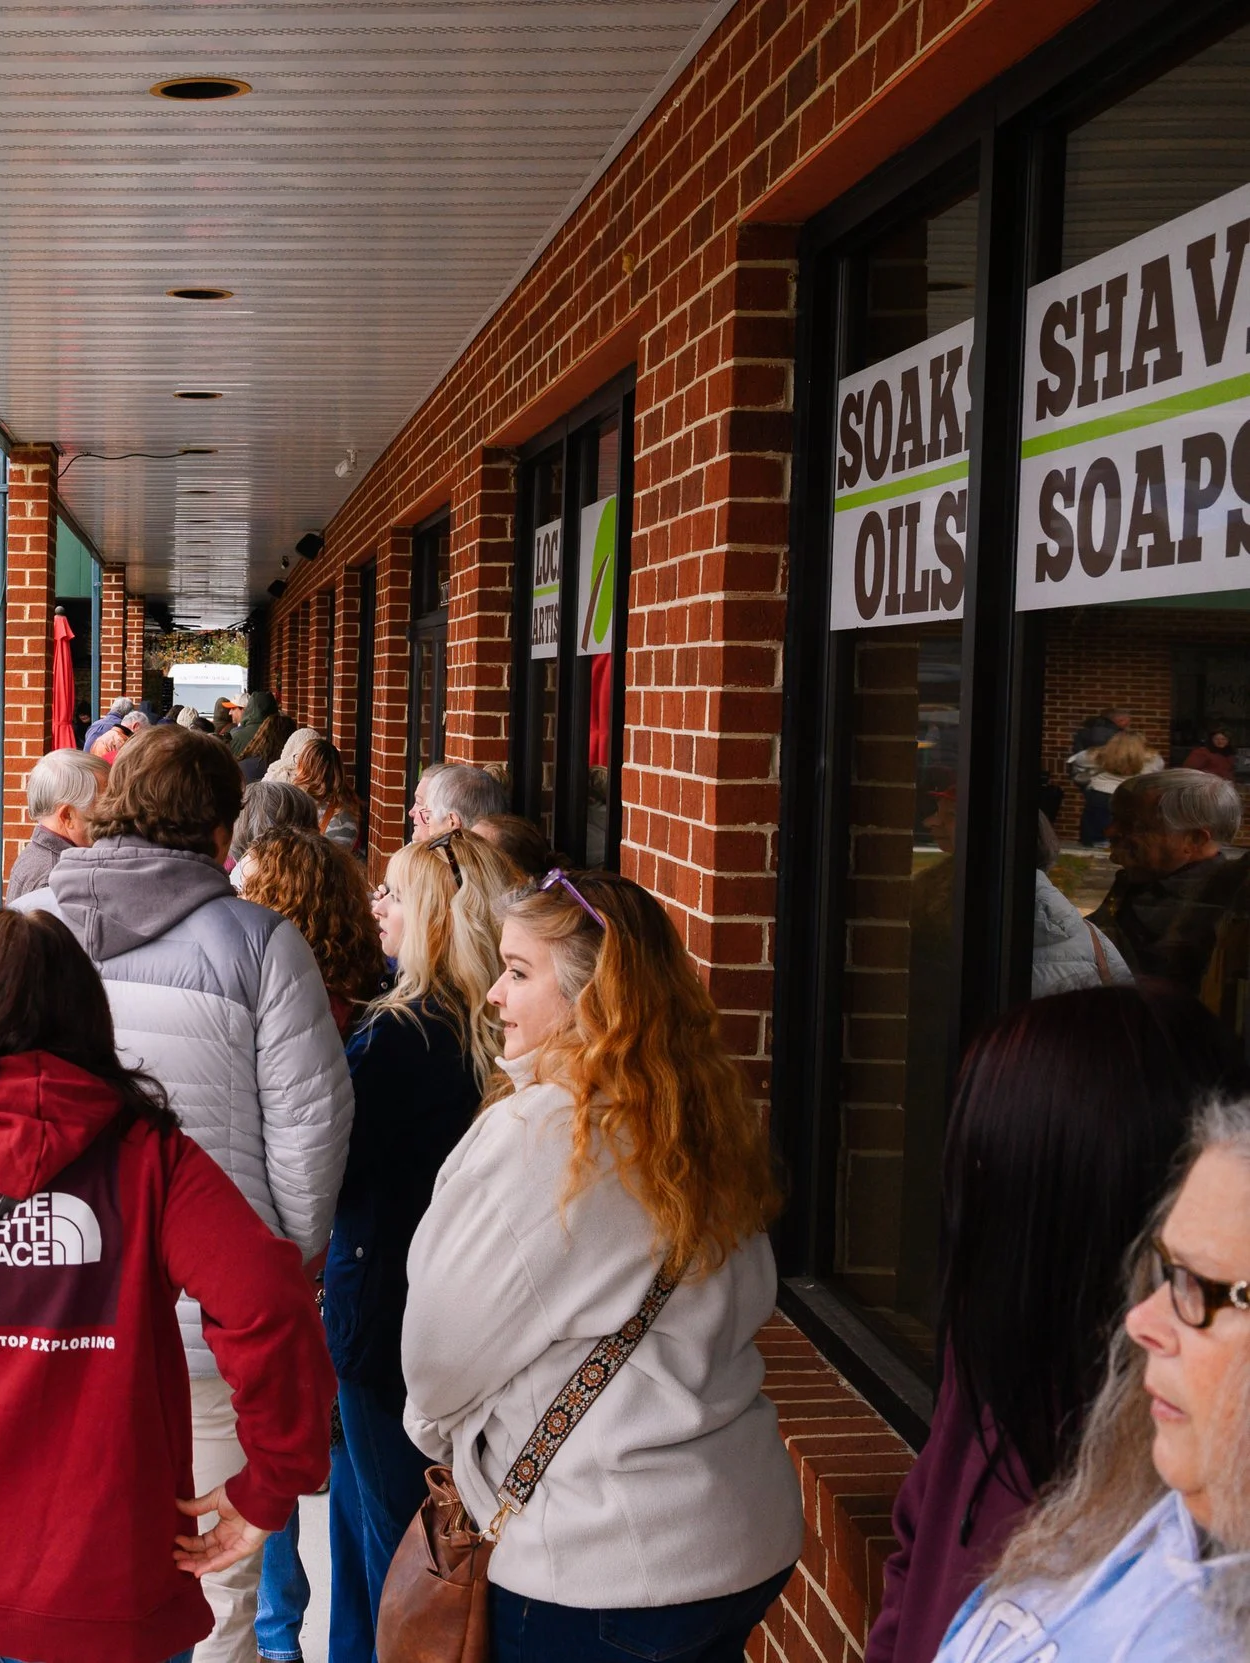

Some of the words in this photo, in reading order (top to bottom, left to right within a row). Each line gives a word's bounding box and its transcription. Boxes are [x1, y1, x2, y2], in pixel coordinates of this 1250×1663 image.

[1036, 218, 1250, 421] SHAV
[535, 527, 561, 586] LOC
[854, 489, 968, 620] OILS
[30, 1336, 115, 1352] EXPLORING
